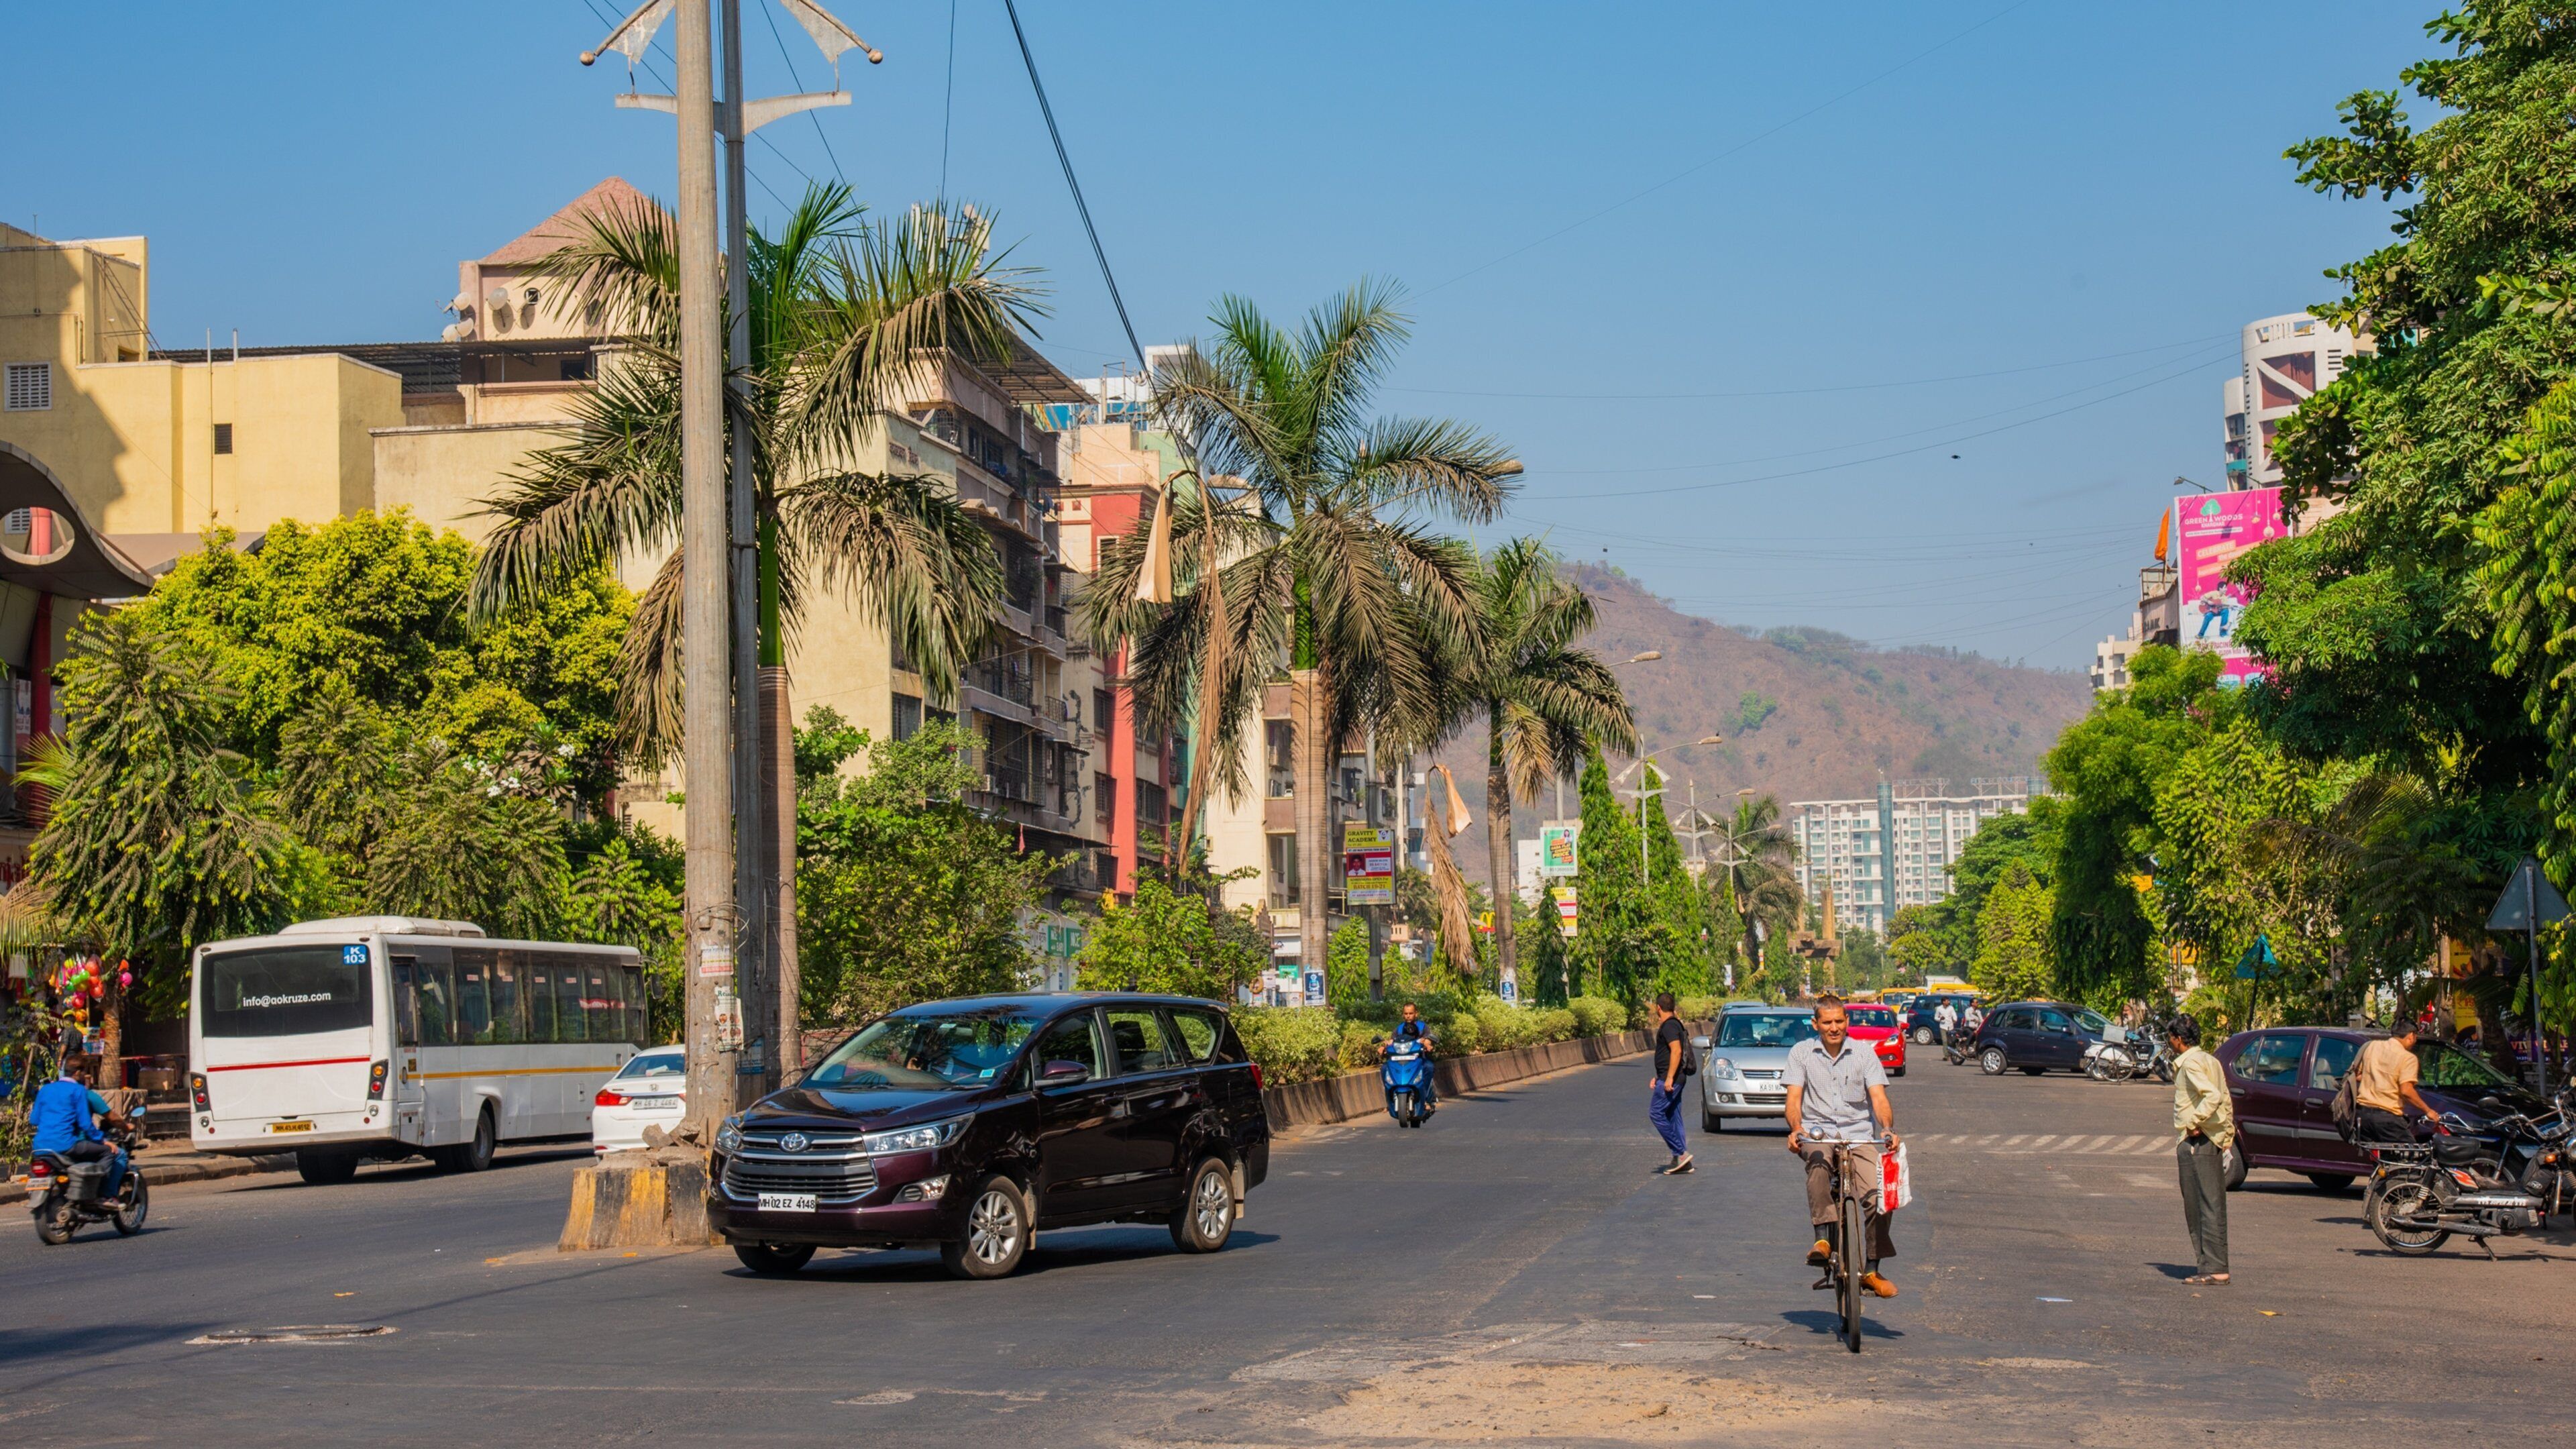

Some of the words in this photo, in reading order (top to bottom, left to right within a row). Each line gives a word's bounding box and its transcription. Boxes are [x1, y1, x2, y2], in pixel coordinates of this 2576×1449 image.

[350, 947, 360, 955] K
[343, 955, 366, 963] 103
[243, 992, 331, 1008] info@aokruze.com
[759, 1199, 770, 1208] MH
[771, 1199, 781, 1208] 02
[783, 1199, 792, 1208] EZ
[796, 1199, 816, 1209] 4148
